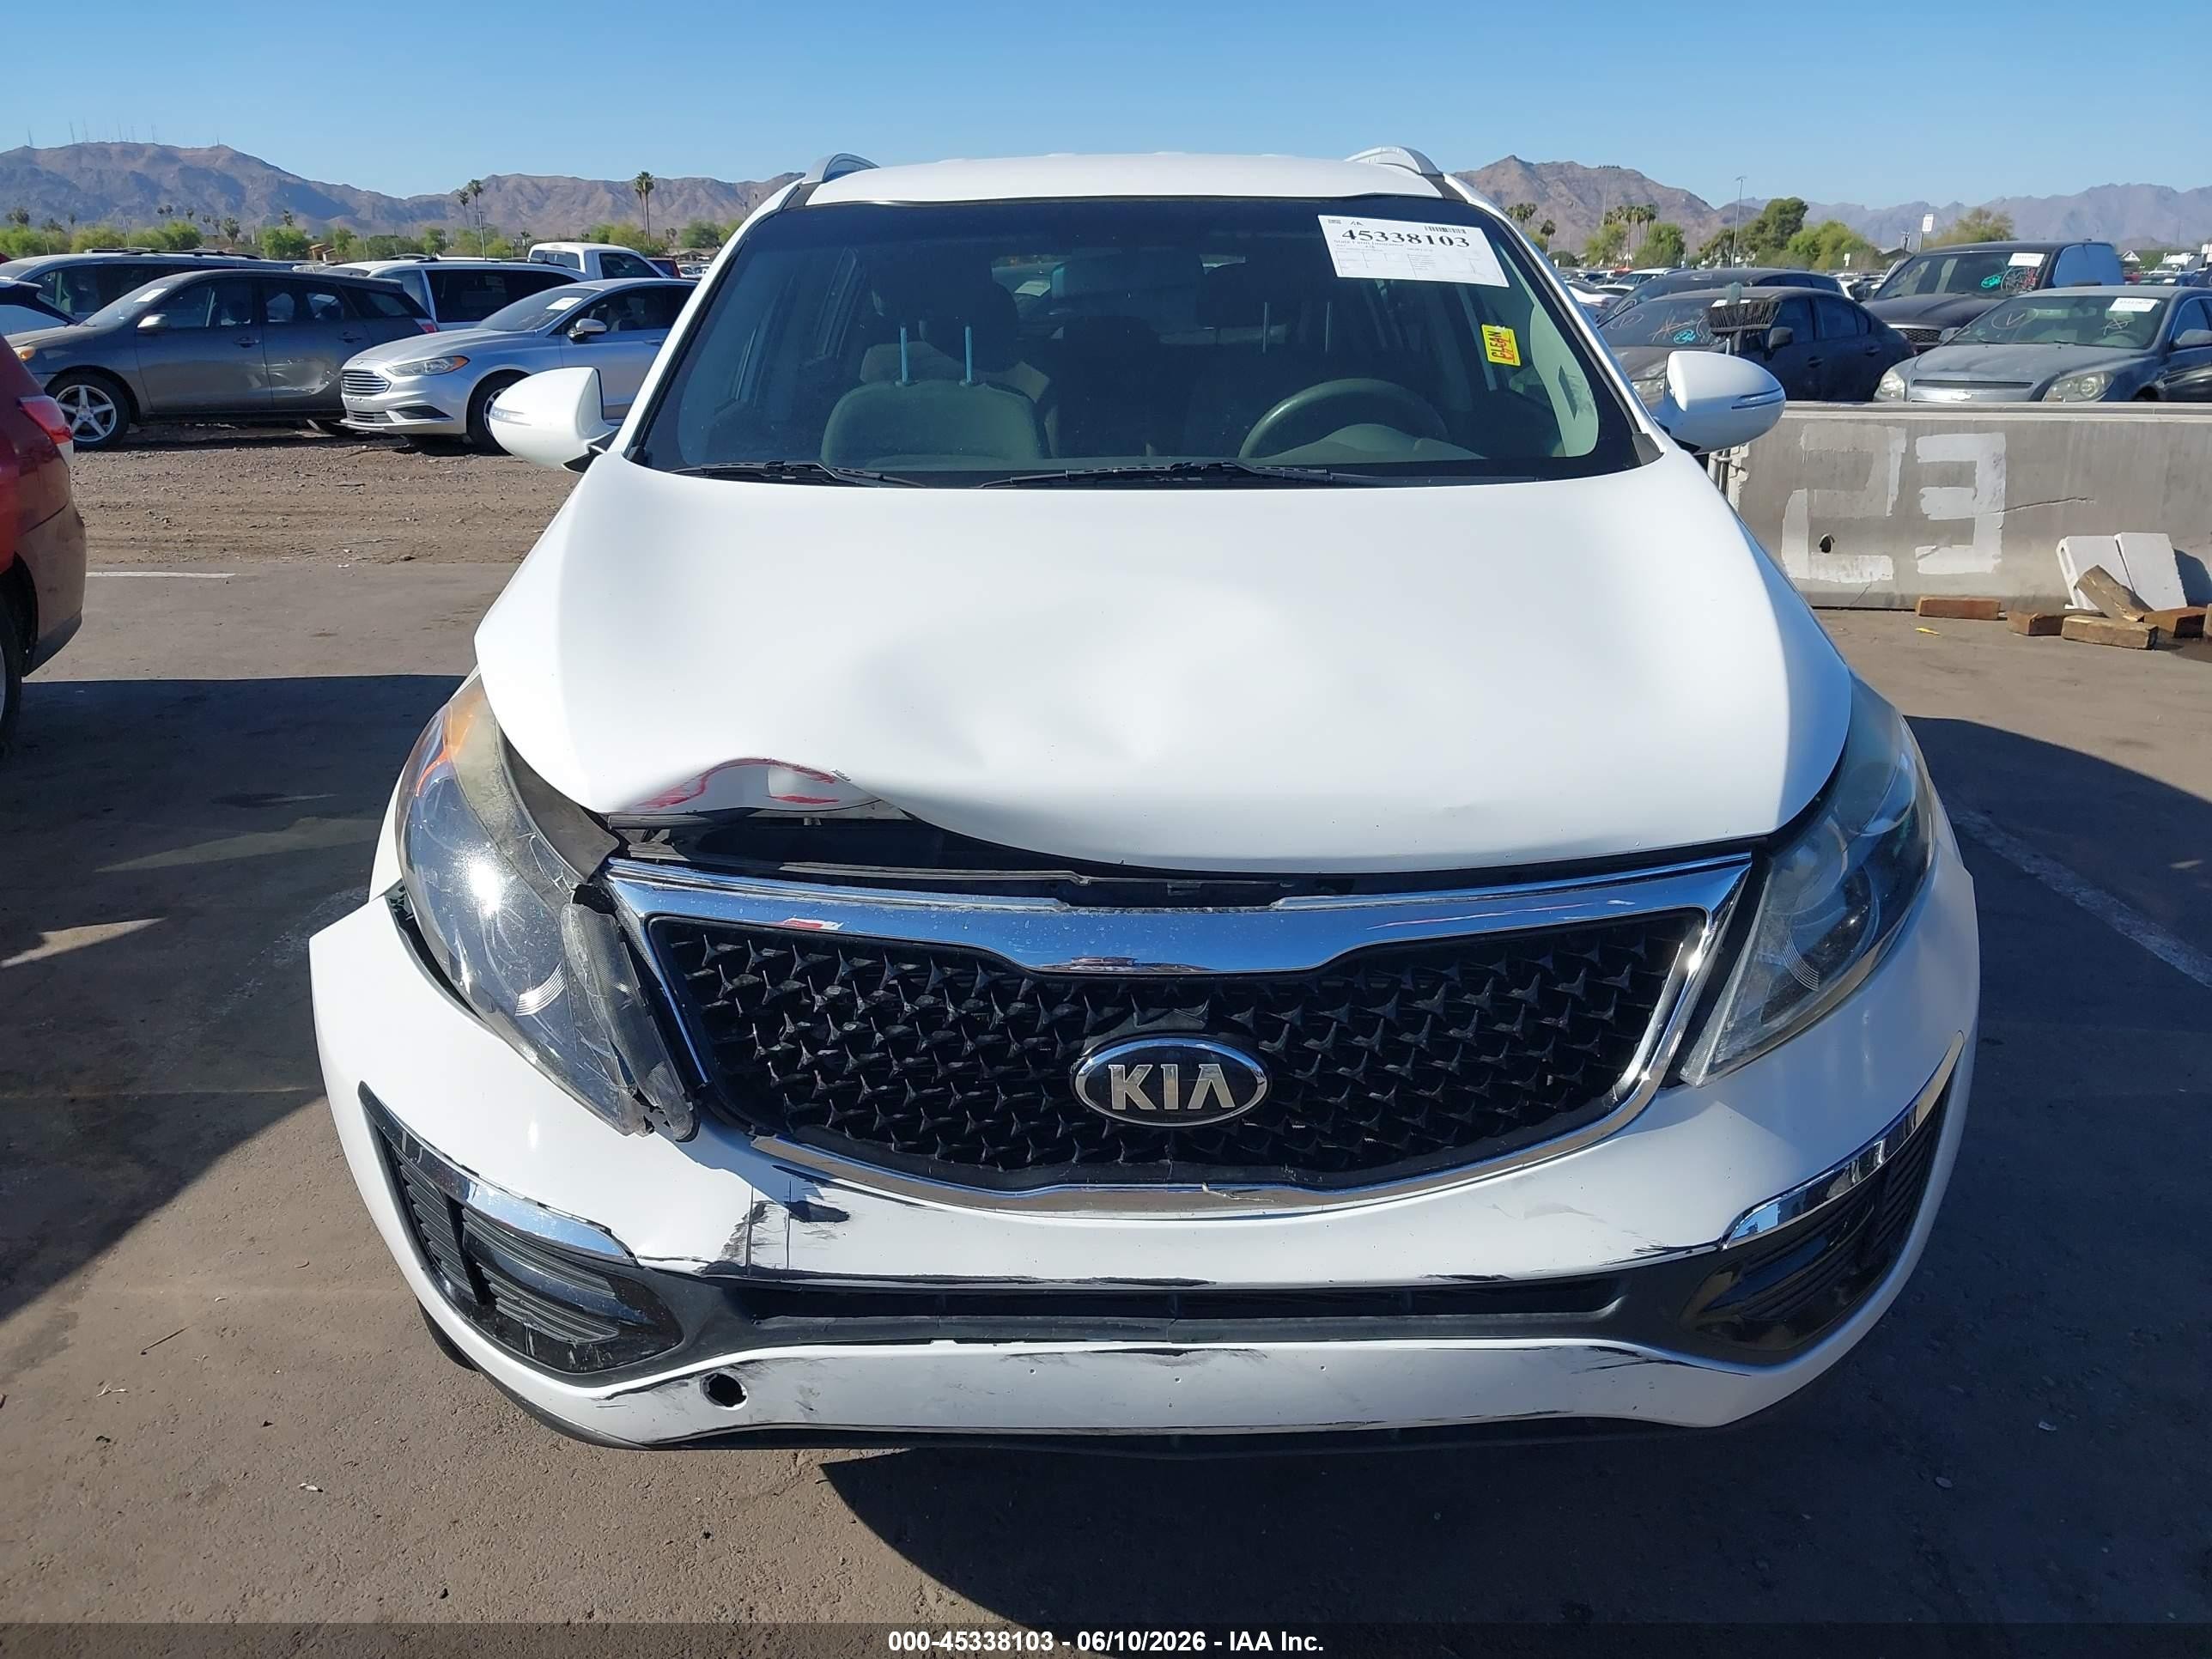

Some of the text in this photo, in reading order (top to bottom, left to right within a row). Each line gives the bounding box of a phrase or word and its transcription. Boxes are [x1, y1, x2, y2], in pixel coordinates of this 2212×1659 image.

[1341, 228, 1470, 248] 45338103
[1486, 330, 1506, 360] CLEAN
[1108, 1063, 1236, 1110] KIA
